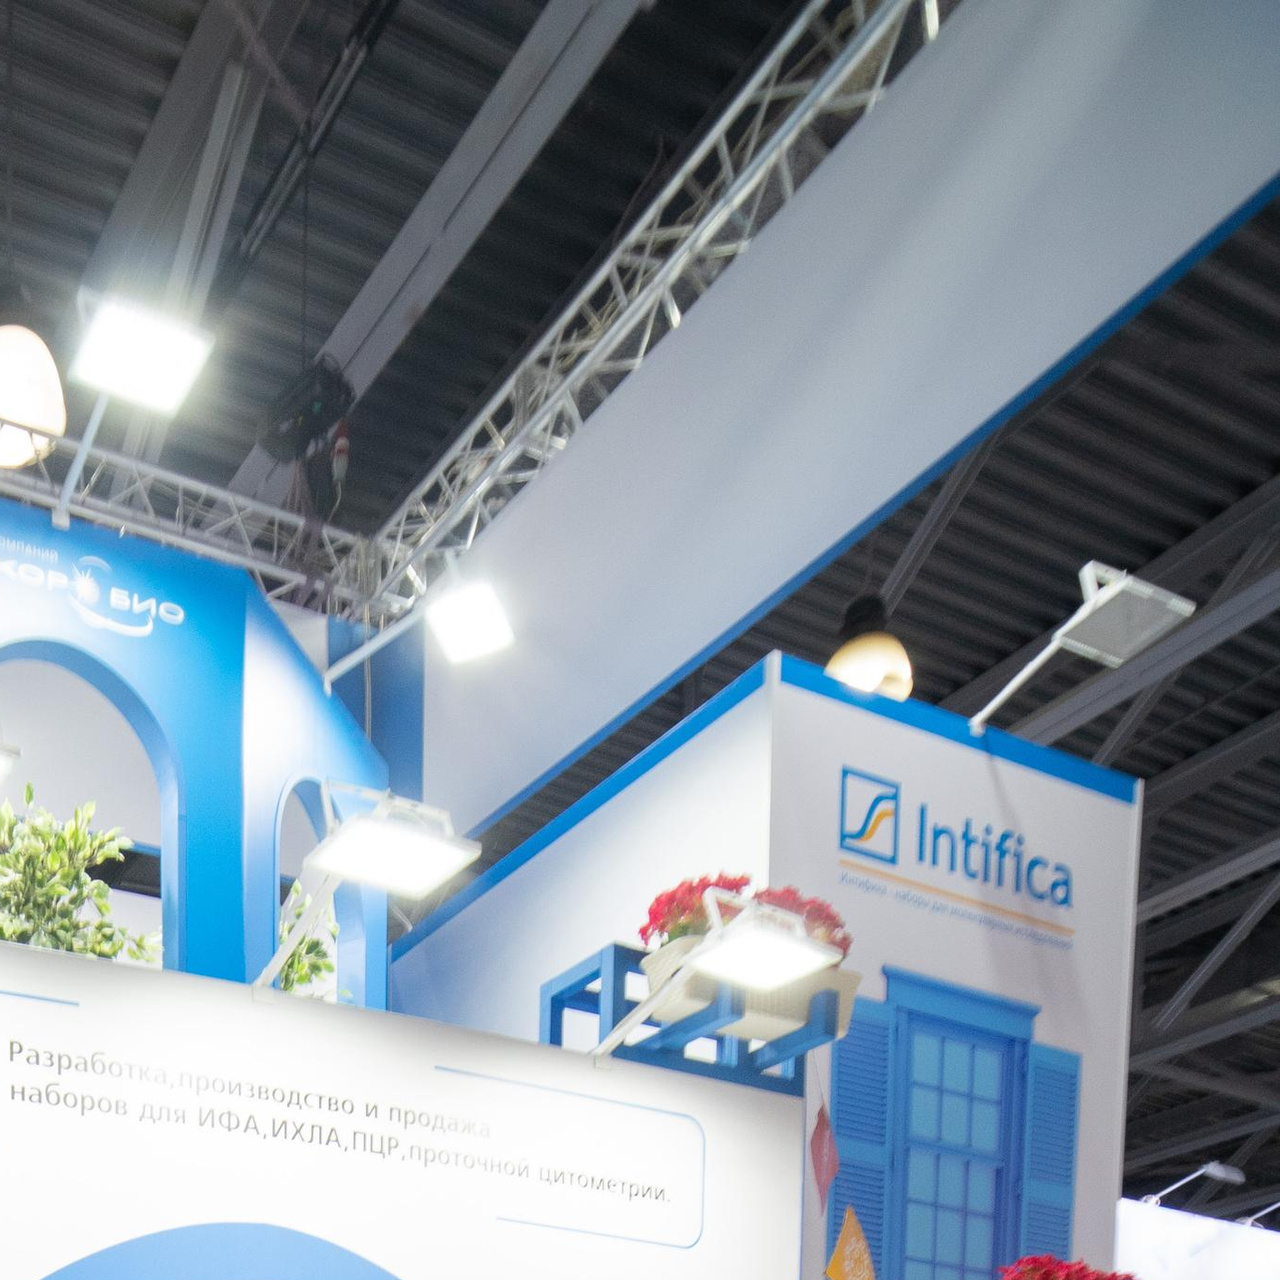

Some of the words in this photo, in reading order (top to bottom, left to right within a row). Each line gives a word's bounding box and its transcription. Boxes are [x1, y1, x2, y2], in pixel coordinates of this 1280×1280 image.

[110, 587, 184, 626] БИО
[916, 802, 1075, 908] Intifica
[10, 1082, 128, 1117] наборов
[138, 1101, 186, 1125] для
[540, 1166, 671, 1204] цитометрии.
[365, 1103, 379, 1119] и
[389, 1104, 491, 1139] продажа
